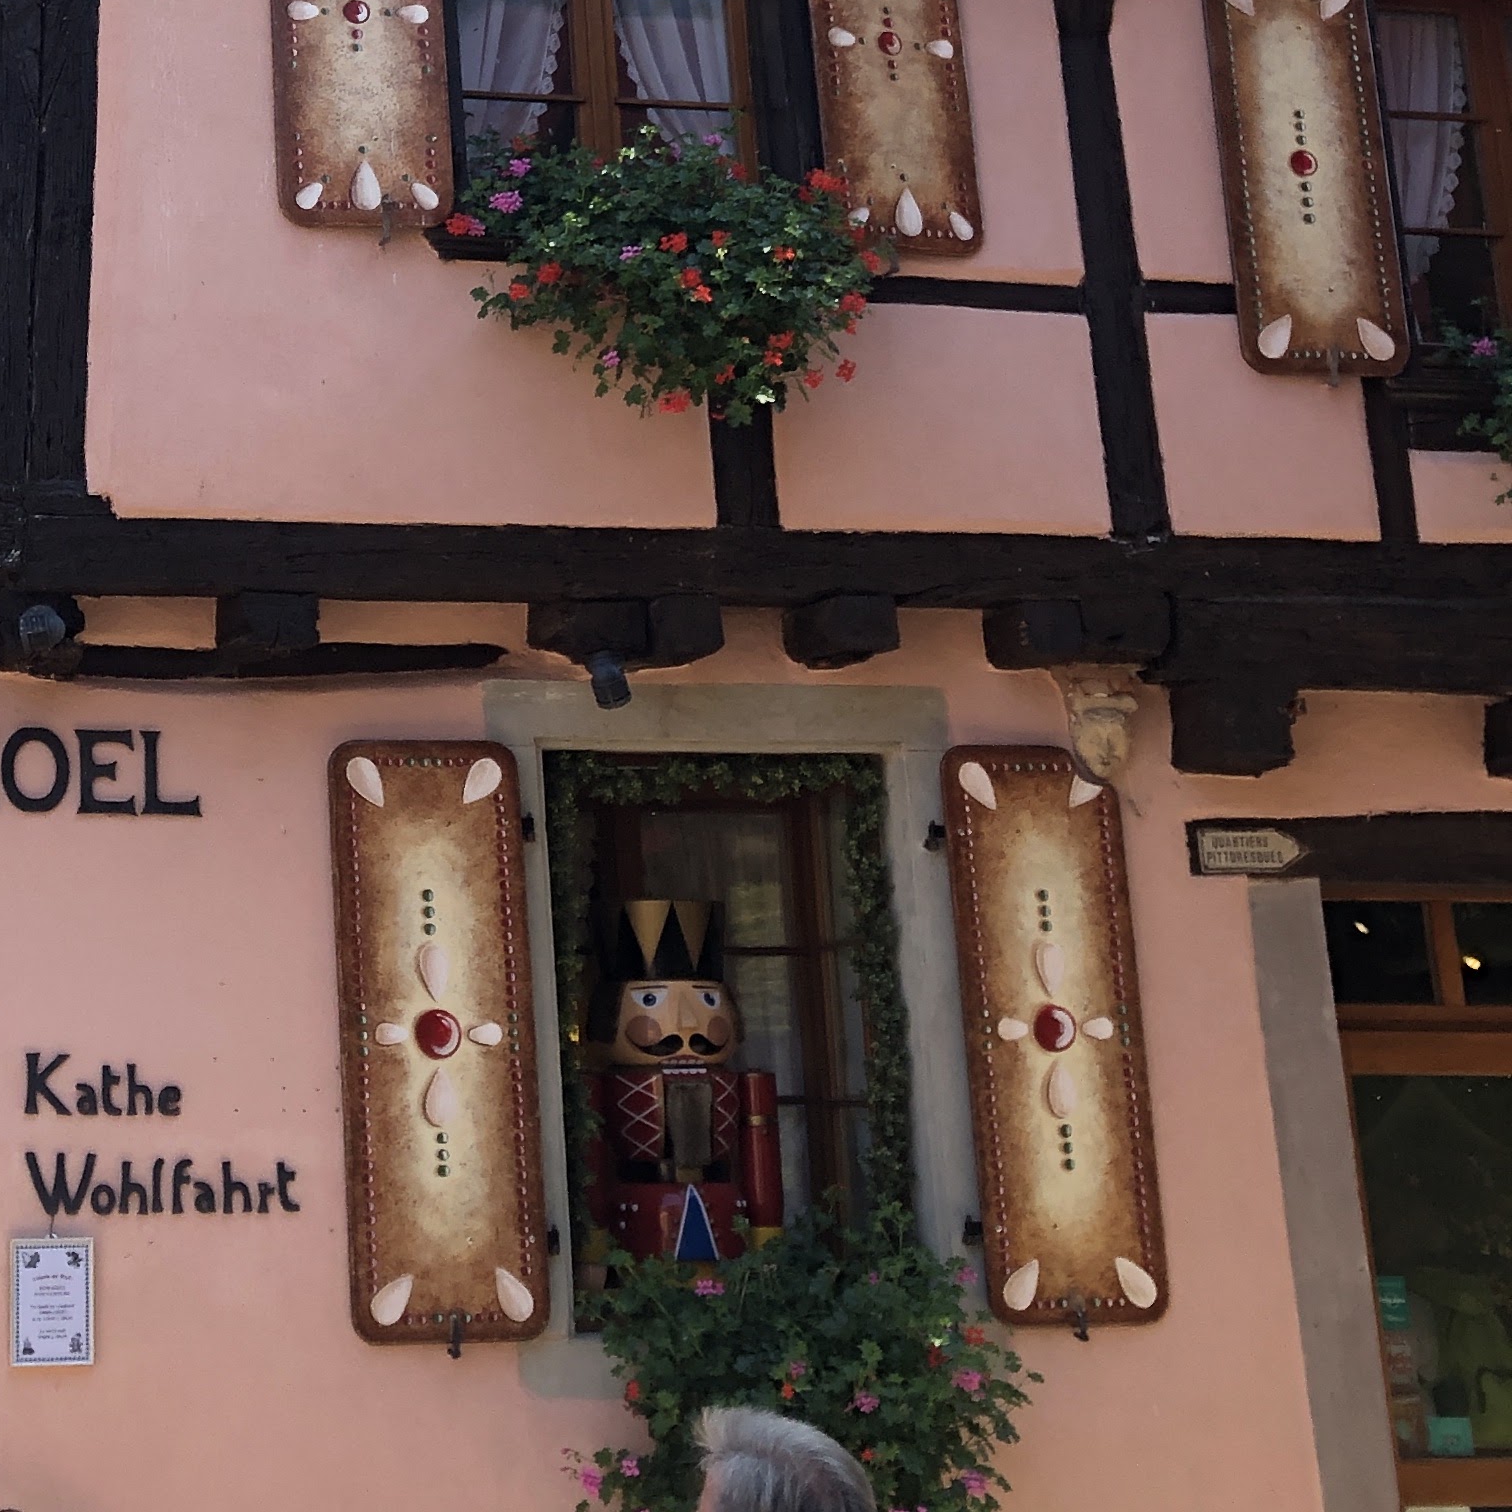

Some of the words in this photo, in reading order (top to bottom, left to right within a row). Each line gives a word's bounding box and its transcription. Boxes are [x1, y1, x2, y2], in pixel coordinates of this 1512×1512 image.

[1211, 835, 1269, 849] QUARTIERS
[24, 1052, 182, 1116] Kathe
[25, 1151, 301, 1216] Wohlfahrt
